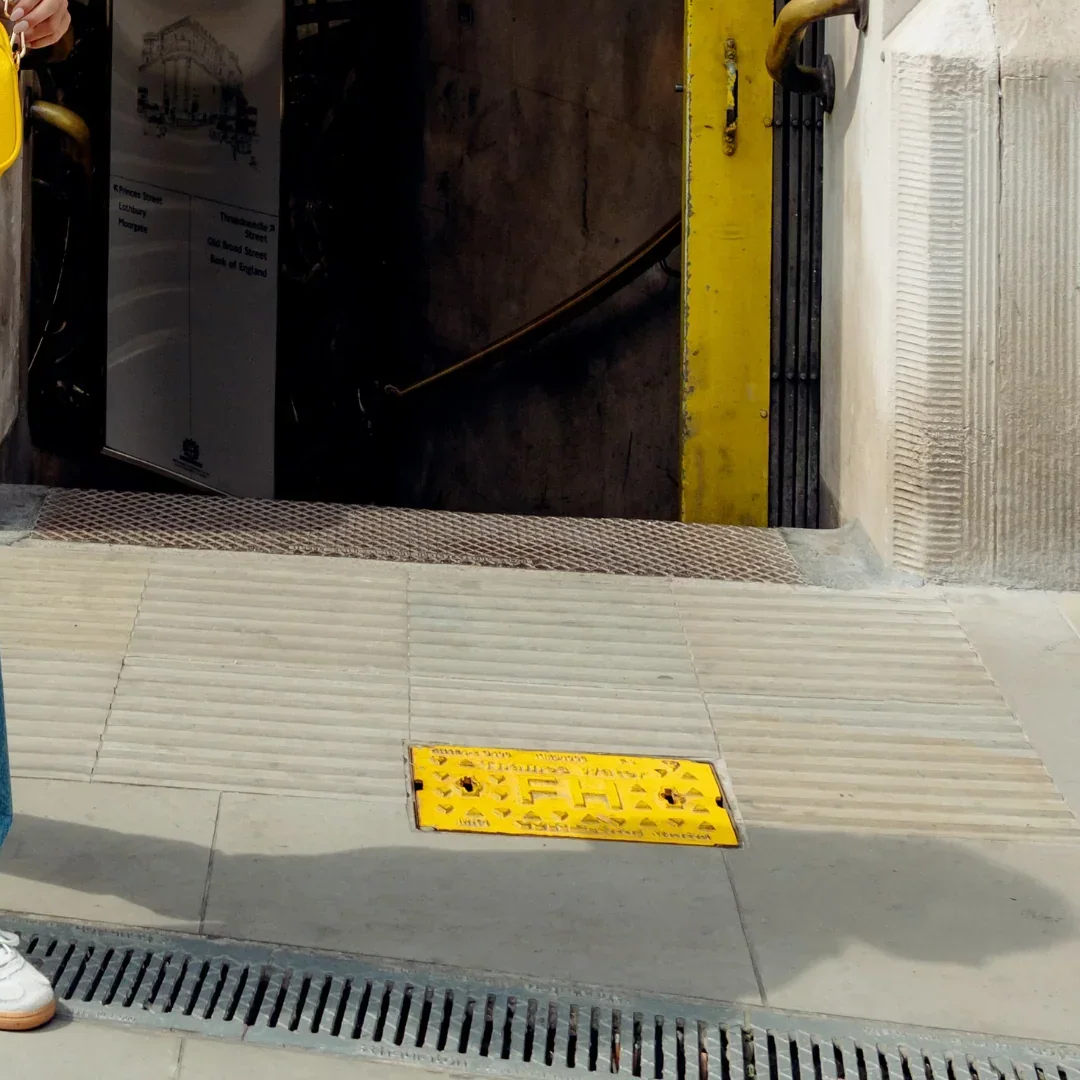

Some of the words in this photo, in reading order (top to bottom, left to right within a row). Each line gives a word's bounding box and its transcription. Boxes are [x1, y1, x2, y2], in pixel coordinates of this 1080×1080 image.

[118, 185, 141, 199] Princes
[142, 191, 163, 205] Street
[118, 201, 147, 219] Lothbury
[118, 217, 149, 234] Moorgate
[244, 229, 268, 244] Street
[207, 236, 221, 248] Old
[222, 240, 243, 254] Broad
[244, 246, 268, 260] Street
[210, 253, 227, 267] Bank
[228, 260, 237, 269] of
[238, 262, 268, 278] England
[517, 774, 623, 810] FH
